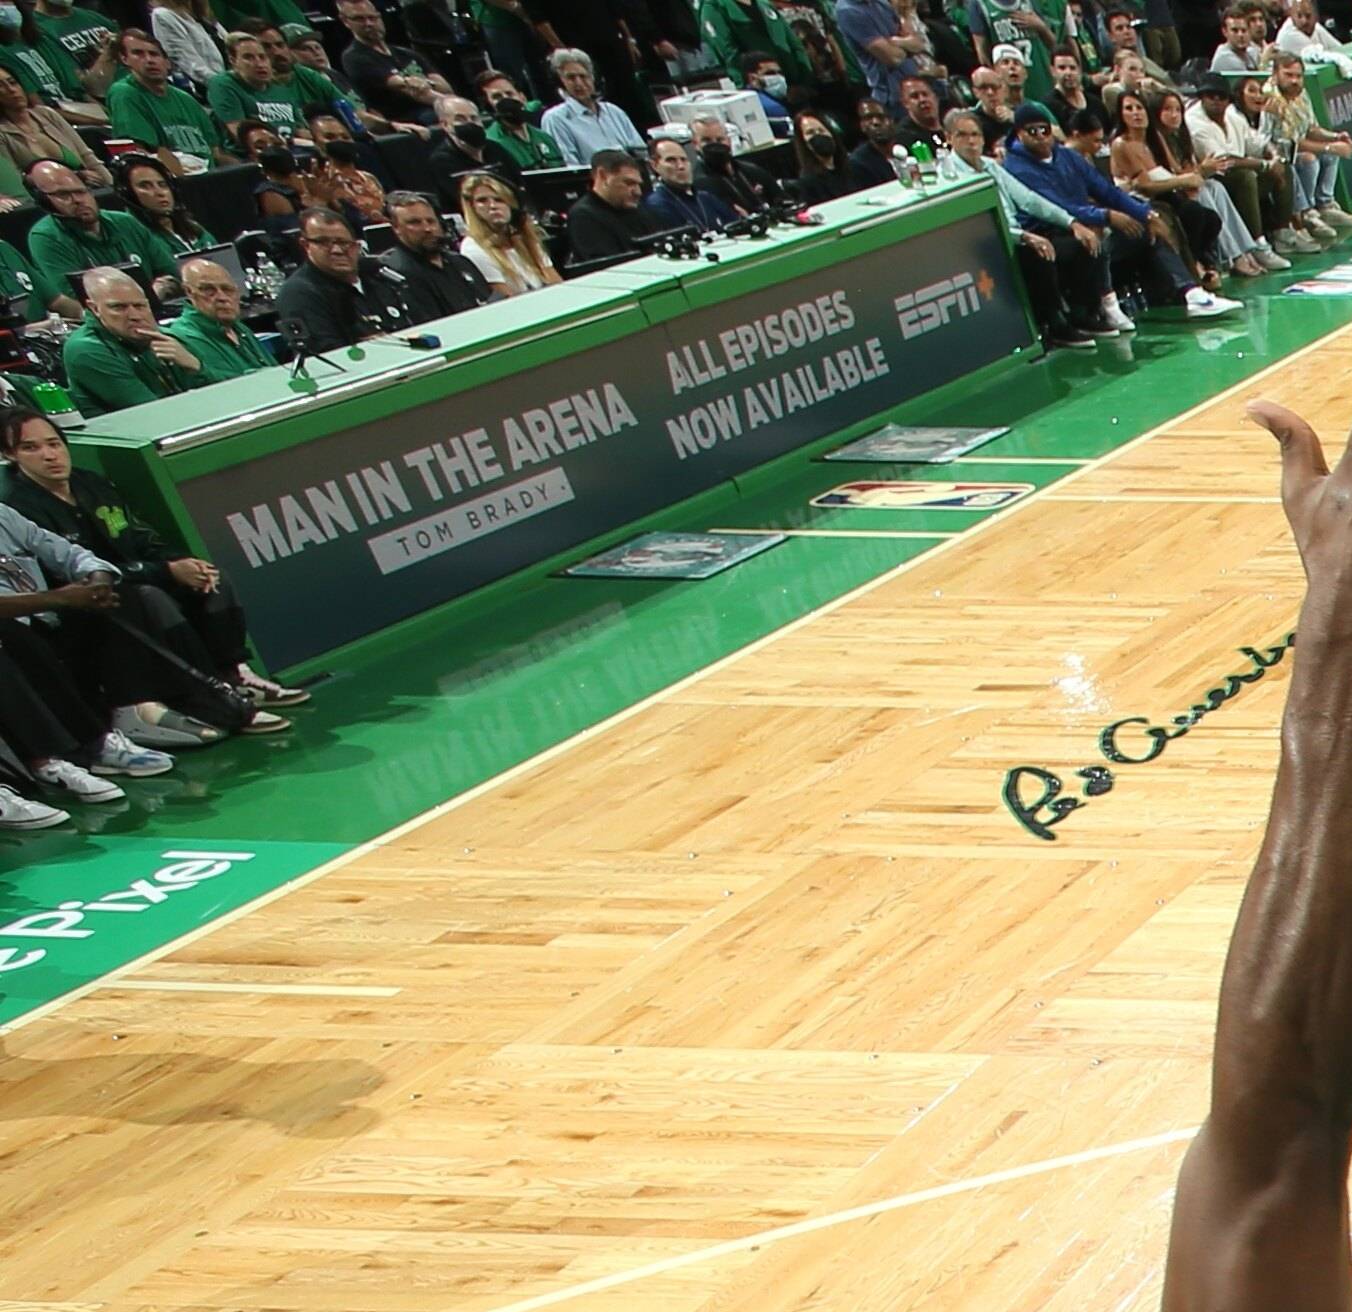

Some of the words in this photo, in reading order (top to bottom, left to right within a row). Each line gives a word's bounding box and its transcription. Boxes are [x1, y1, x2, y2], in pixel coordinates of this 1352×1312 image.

[665, 340, 727, 395] ALL
[718, 290, 856, 373] EPISODES
[665, 394, 743, 460] NOW
[743, 337, 891, 430] AVAILABLE
[226, 478, 358, 569] MAN
[346, 460, 413, 525] IN
[403, 427, 505, 501] THE
[502, 383, 639, 471] ARENA
[396, 521, 454, 557] TOM
[466, 482, 550, 530] BRADY
[0, 850, 256, 939] Pixel
